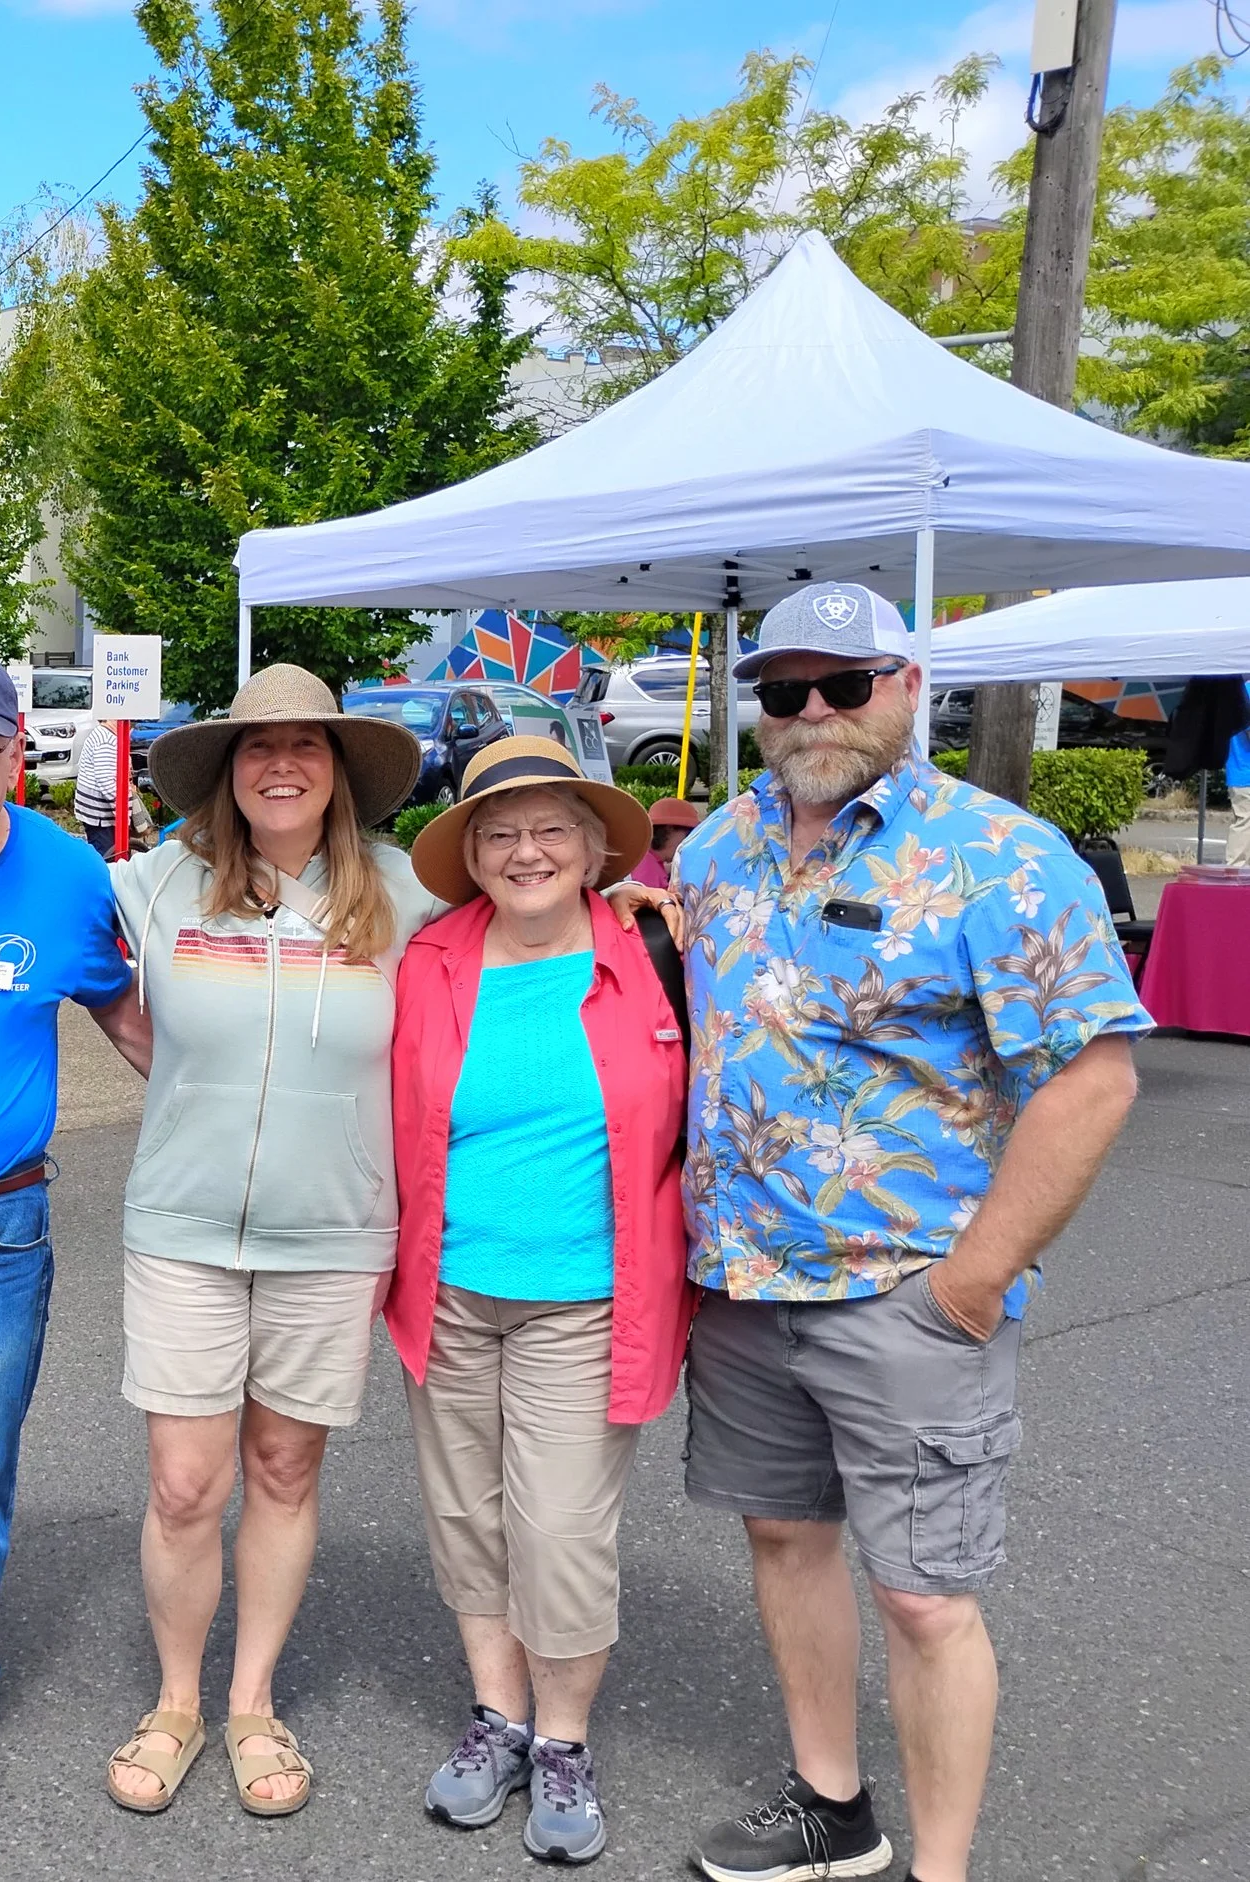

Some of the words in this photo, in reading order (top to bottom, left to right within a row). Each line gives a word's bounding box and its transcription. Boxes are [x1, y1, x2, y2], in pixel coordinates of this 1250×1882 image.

[106, 651, 129, 662] Bank
[106, 666, 148, 676] Customer
[106, 680, 140, 692] Parking
[106, 694, 125, 706] Only
